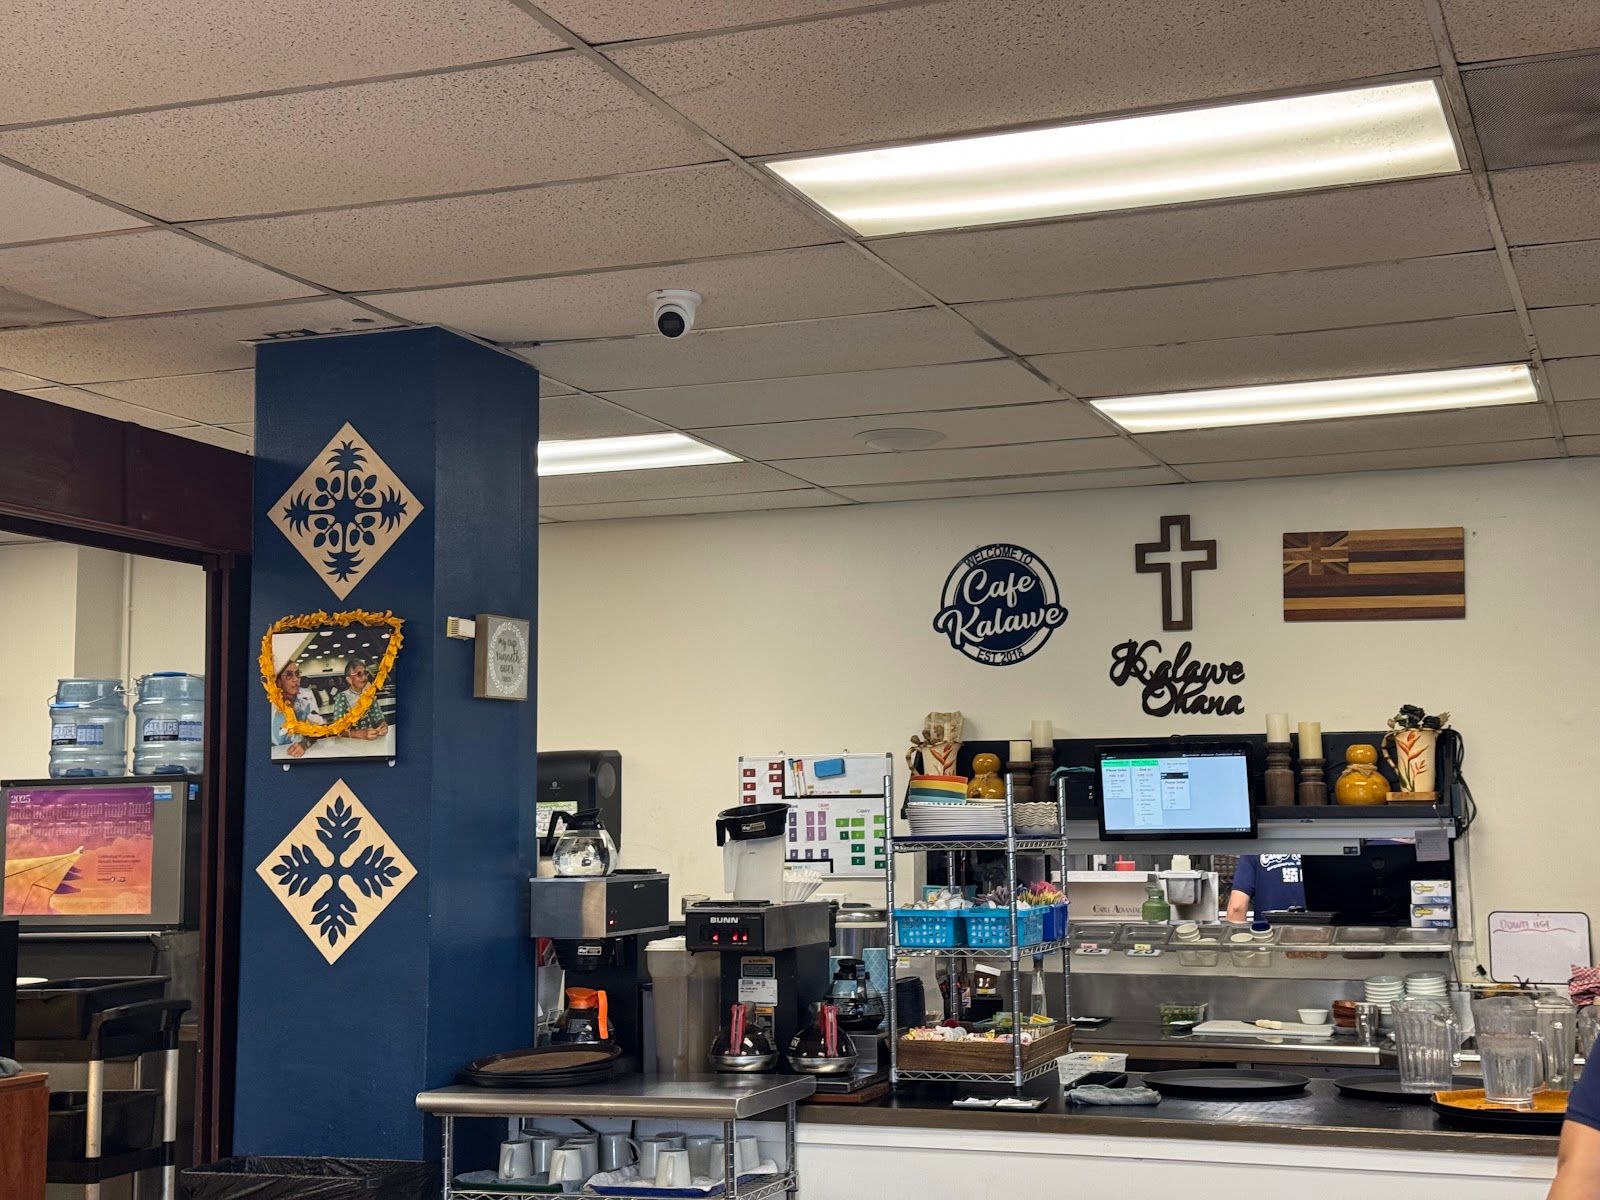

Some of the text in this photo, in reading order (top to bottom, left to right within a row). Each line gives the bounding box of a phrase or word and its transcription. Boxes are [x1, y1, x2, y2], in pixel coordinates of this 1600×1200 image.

[963, 546, 1034, 568] WELCOME TO
[962, 568, 1036, 609] Cafe
[937, 606, 1065, 646] Kalawe
[978, 648, 1025, 664] EST 2018
[1109, 638, 1246, 687] Kalawe
[1141, 680, 1246, 717] Ohana
[10, 794, 31, 804] 2025
[709, 916, 739, 924] BUNN
